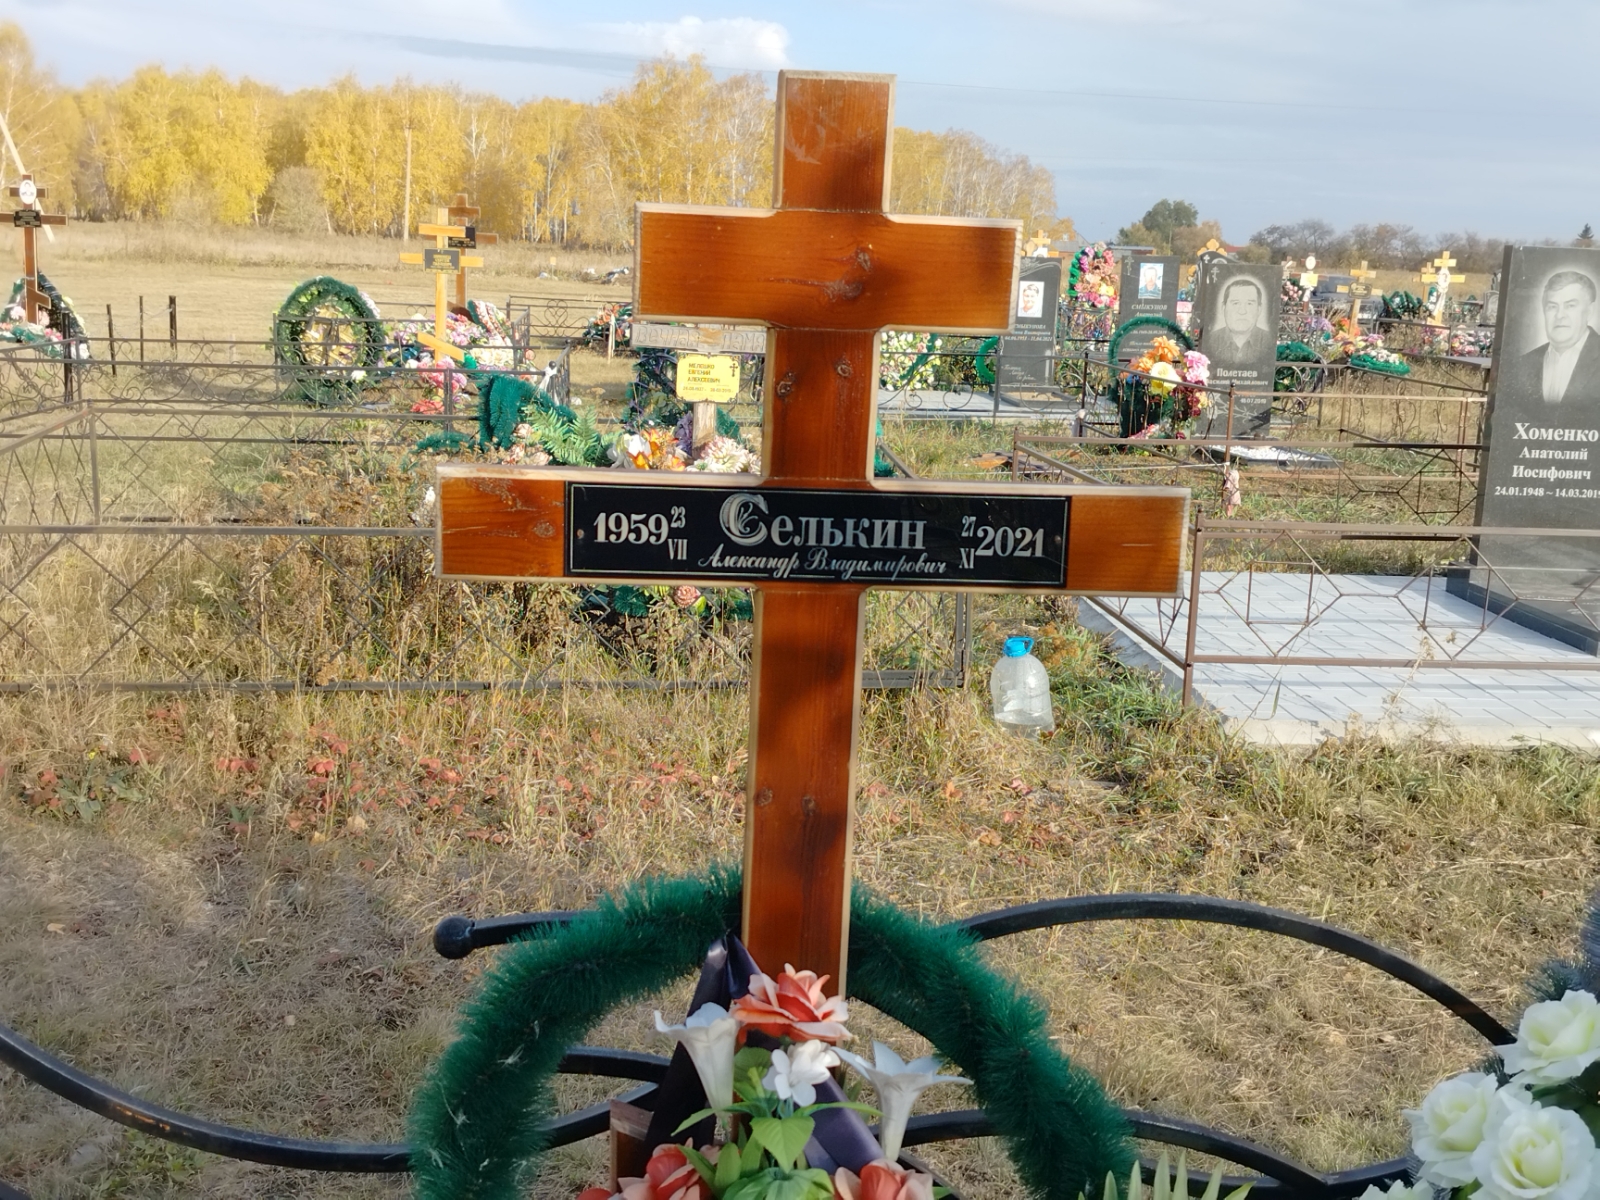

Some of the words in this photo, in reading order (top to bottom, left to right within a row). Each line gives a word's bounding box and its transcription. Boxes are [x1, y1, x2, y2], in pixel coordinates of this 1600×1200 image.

[1216, 368, 1258, 378] Полетаев
[1512, 422, 1600, 442] Хоменко
[1519, 446, 1589, 461] Анатолий
[1511, 465, 1592, 482] Иосифович
[1494, 486, 1545, 497] 24.01.1948
[593, 511, 669, 545] 1959
[670, 506, 686, 529] 23
[719, 492, 927, 550] Селькин
[975, 525, 1044, 557] 2021
[698, 543, 801, 579] Александр
[803, 547, 947, 582] Владимирович
